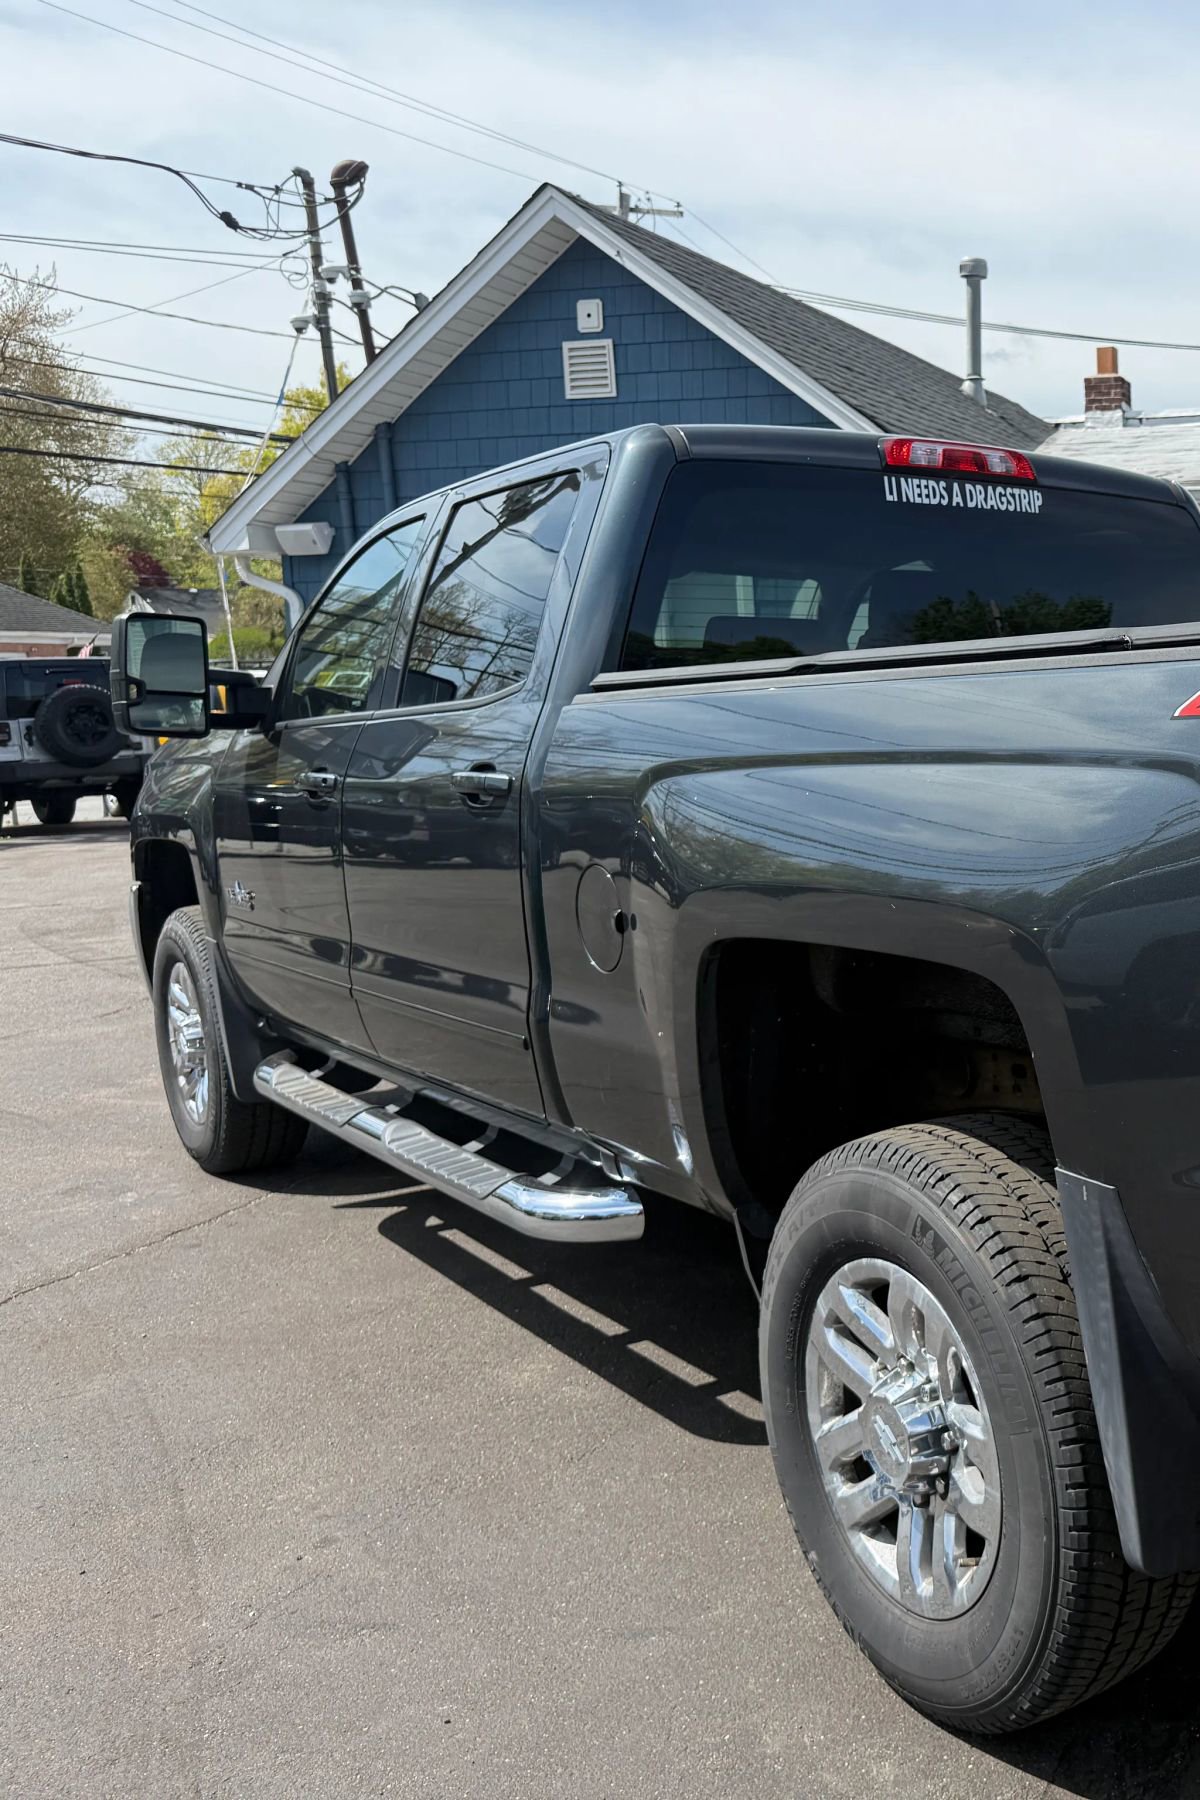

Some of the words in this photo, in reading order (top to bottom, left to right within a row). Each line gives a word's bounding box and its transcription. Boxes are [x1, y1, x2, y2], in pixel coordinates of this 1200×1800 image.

[883, 475, 898, 502] LI
[899, 477, 949, 506] NEEDS
[952, 482, 964, 508] A
[965, 483, 1043, 514] DRAGSTRIP
[934, 1246, 1029, 1424] MICHELIN
